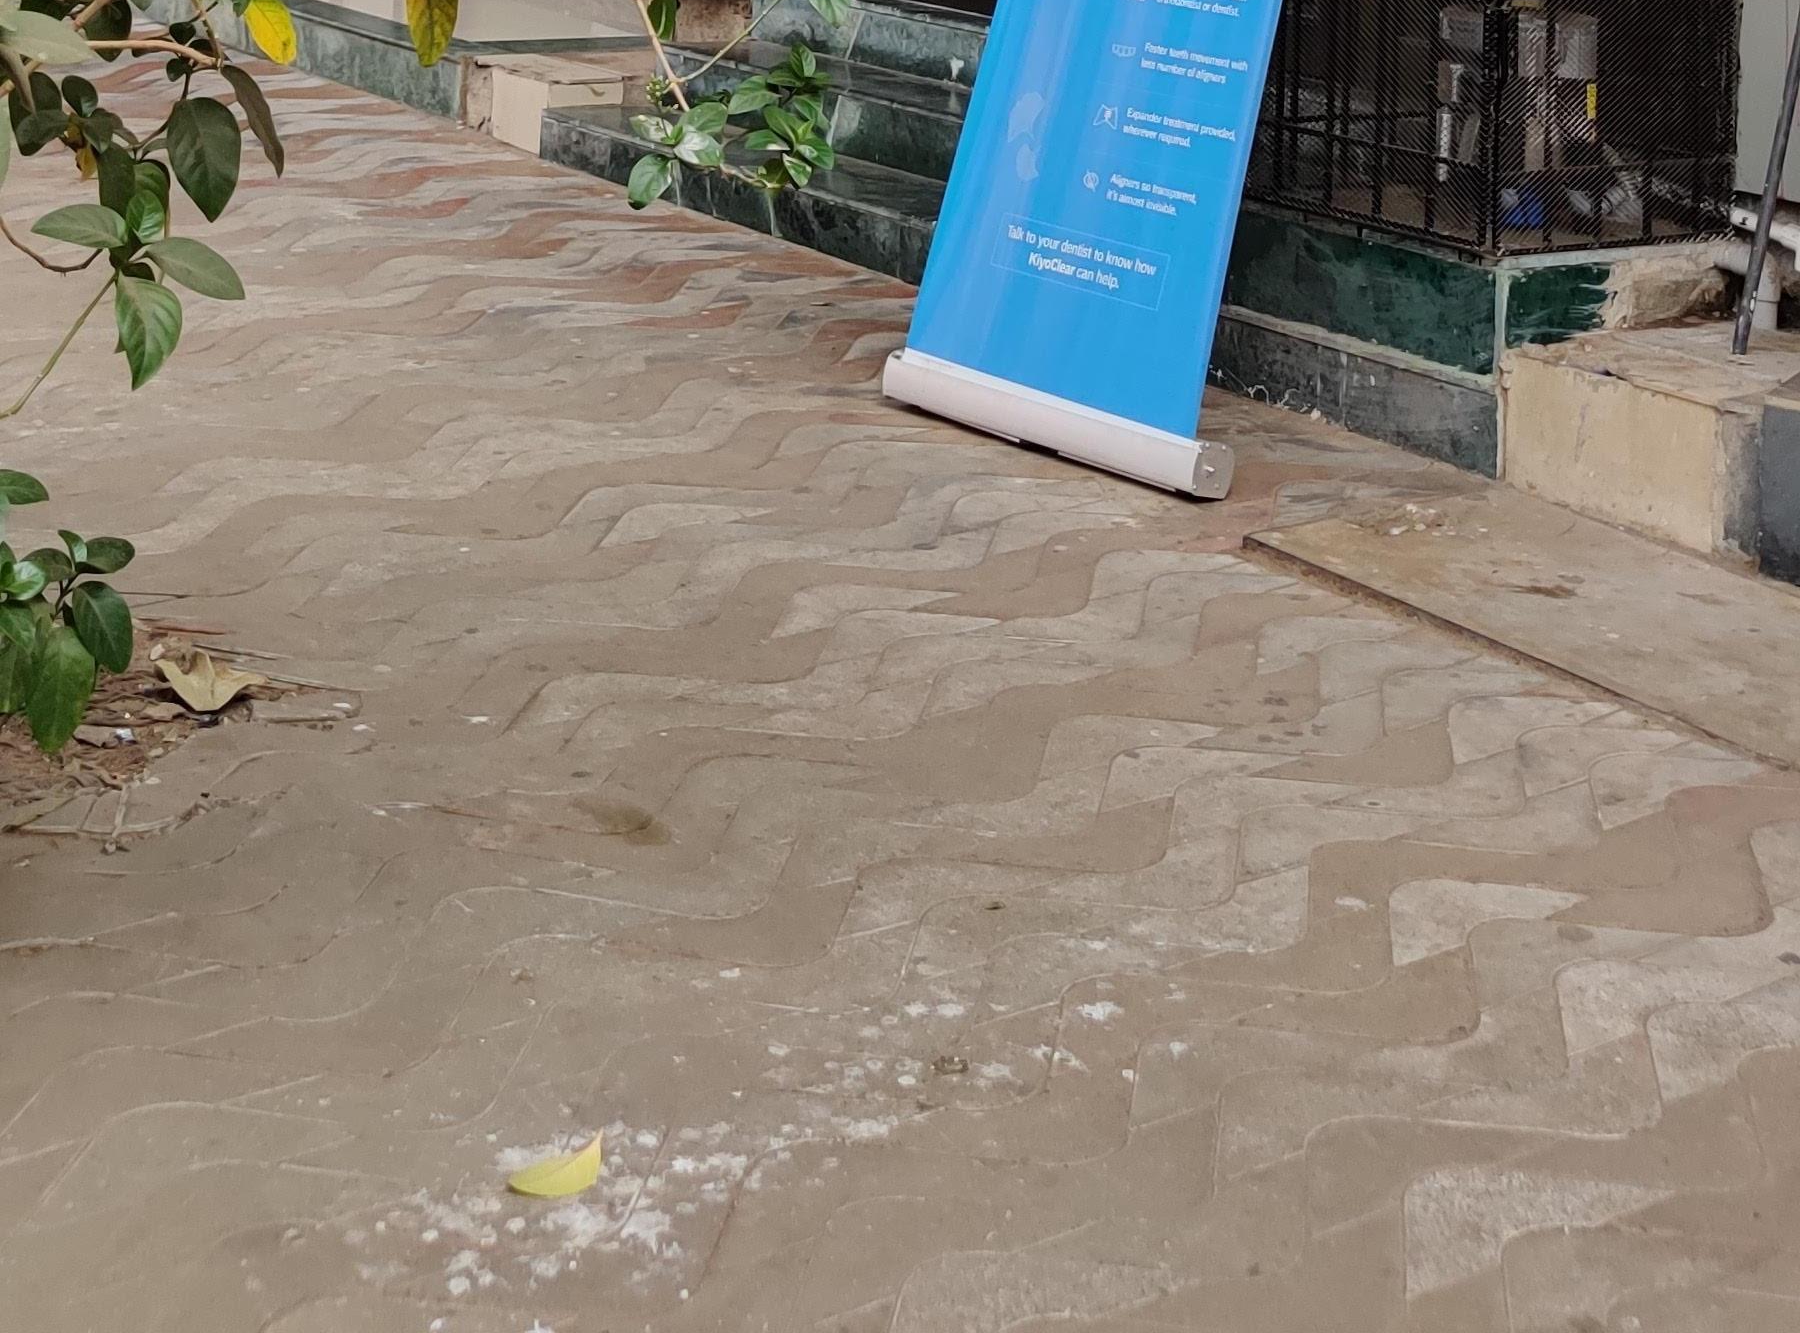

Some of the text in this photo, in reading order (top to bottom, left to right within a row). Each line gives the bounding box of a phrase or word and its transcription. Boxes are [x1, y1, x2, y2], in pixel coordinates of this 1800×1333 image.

[1202, 3, 1211, 12] or
[1145, 42, 1248, 72] Faster teeth movement with
[1156, 62, 1186, 76] number
[1187, 67, 1195, 77] of
[1127, 107, 1162, 123] Expander
[1163, 116, 1199, 132] treatment
[1123, 124, 1158, 139] wherever
[1110, 173, 1140, 189] Aligners
[1141, 182, 1151, 192] so
[1119, 194, 1145, 208] almost
[1008, 224, 1157, 276] Talk to your dentist to know how
[1028, 252, 1120, 290] KiyoClear can help.
